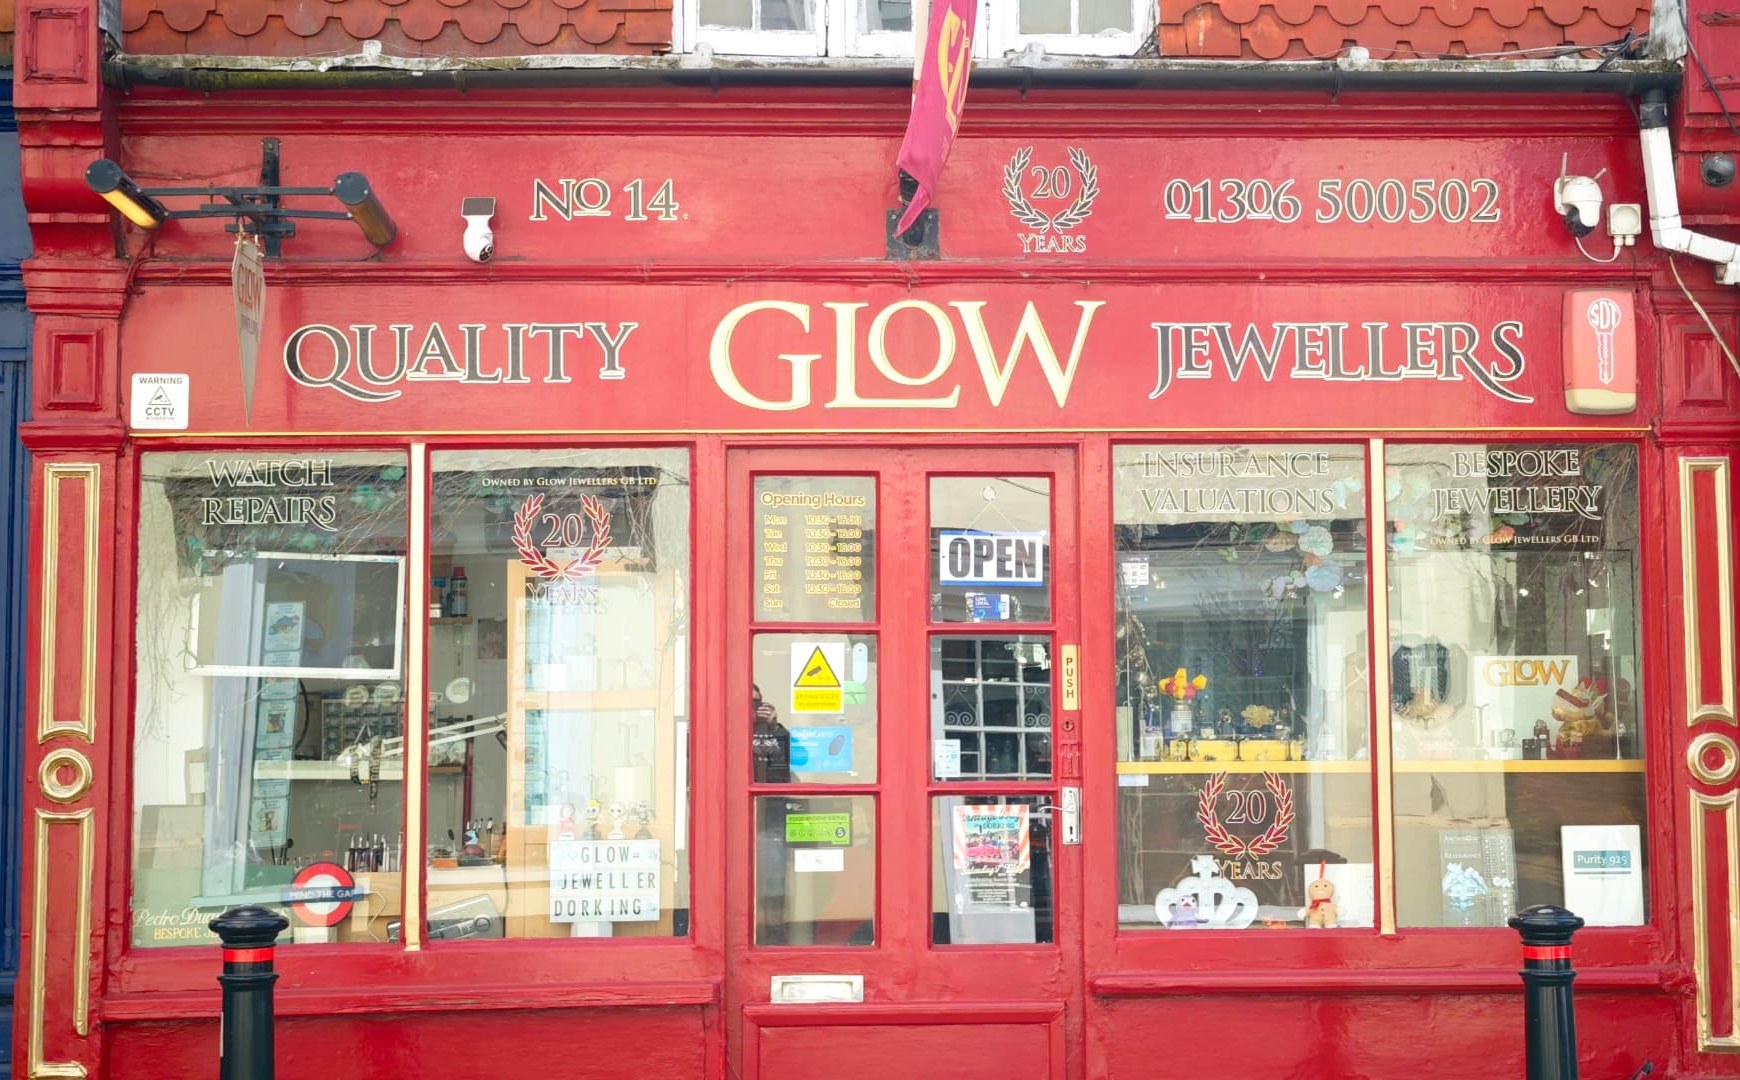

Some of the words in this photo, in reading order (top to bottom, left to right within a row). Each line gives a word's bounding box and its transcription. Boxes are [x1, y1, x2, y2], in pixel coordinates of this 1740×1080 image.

[1030, 166, 1071, 200] 20
[1165, 179, 1301, 223] 01306
[1315, 178, 1500, 223] 500502
[1018, 234, 1086, 253] YEARS
[283, 322, 639, 402] QUALITY
[709, 299, 1106, 411] GLOW
[1148, 321, 1534, 404] JEWELLERS
[139, 376, 183, 384] WARNING
[145, 407, 174, 416] CCTV
[207, 458, 334, 487] WATCH
[1142, 452, 1330, 478] INSURANCE
[1453, 450, 1580, 478] BESPOKE
[620, 476, 636, 486] GB
[638, 477, 657, 485] LTD
[761, 491, 822, 509] Opening
[823, 492, 865, 507] Hours
[1140, 487, 1334, 514] VALUATIONS
[1432, 485, 1603, 522] JEWELLERY
[202, 496, 337, 532] REPAIRS
[541, 513, 584, 548] 20
[1563, 535, 1577, 543] GB
[1581, 535, 1599, 543] LTD
[948, 537, 1037, 578] OPEN
[1066, 657, 1075, 699] PUSH
[1483, 659, 1571, 687] GLOW
[1226, 790, 1267, 824] 20
[581, 847, 630, 864] GLOW
[1577, 854, 1607, 866] Purity
[1609, 855, 1628, 866] 925
[561, 872, 656, 890] JEWELLER
[1218, 860, 1283, 880] YEARS
[319, 890, 336, 899] THE
[554, 898, 642, 917] DORKING
[154, 927, 201, 941] BESPOKE
